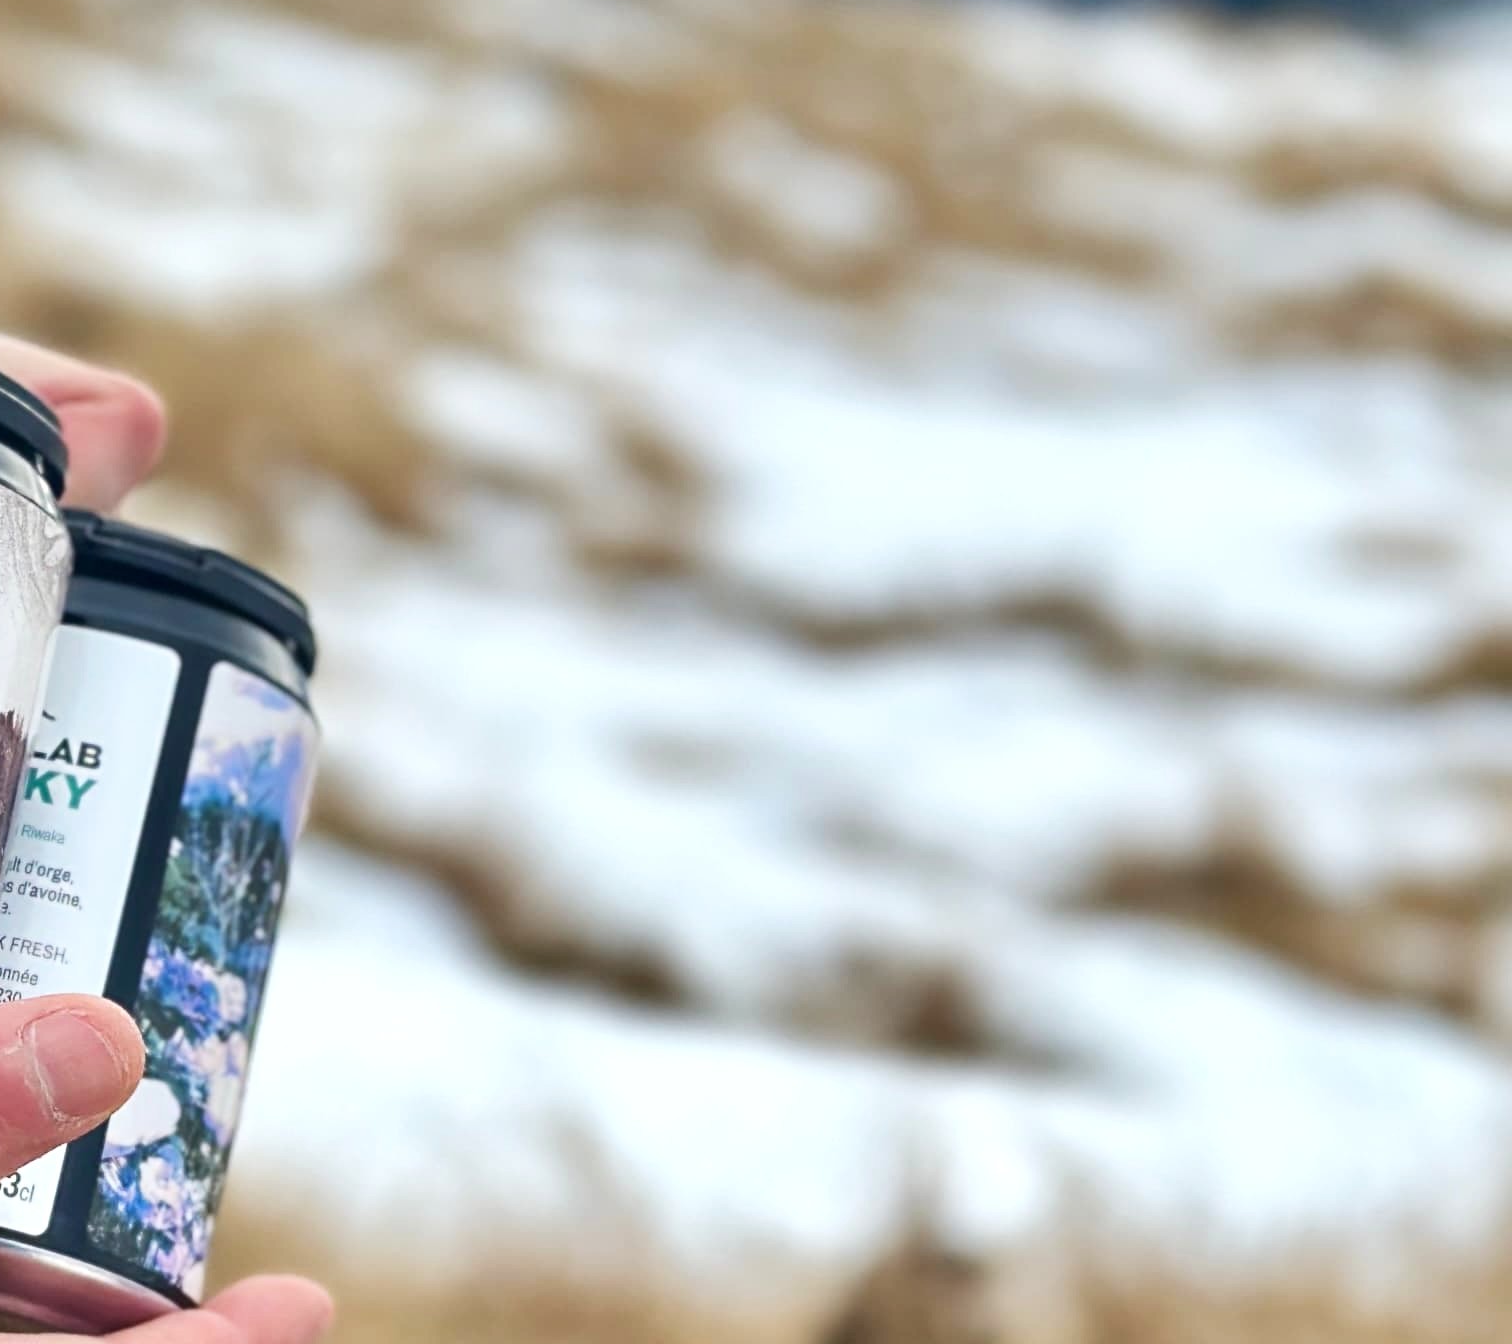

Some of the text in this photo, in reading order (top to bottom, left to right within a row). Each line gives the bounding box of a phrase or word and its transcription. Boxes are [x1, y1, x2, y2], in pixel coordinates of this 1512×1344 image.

[23, 767, 97, 811] KY
[24, 859, 75, 886] d'orge,
[17, 881, 84, 911] d'avoine,
[9, 937, 70, 965] FRESH.
